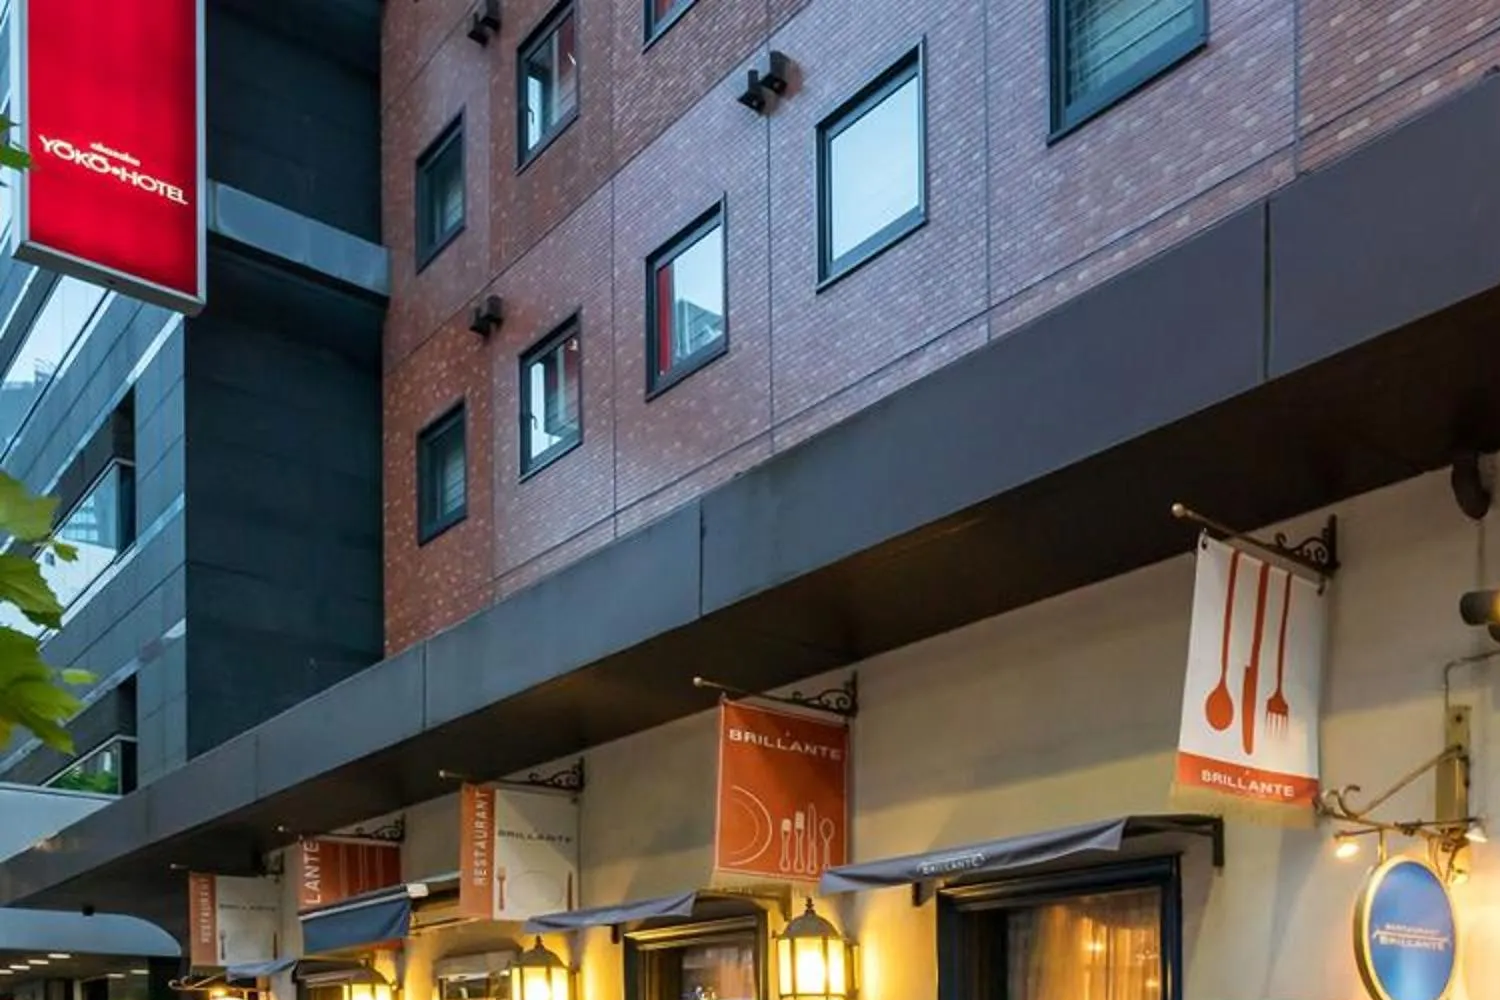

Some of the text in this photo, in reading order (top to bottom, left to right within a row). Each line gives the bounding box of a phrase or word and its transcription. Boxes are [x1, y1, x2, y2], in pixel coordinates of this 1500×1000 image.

[119, 166, 189, 206] HOTEL
[728, 727, 842, 761] BRILLANTE
[1200, 768, 1295, 798] BRILLANTE
[472, 790, 489, 887] RESTAURANT
[498, 829, 573, 844] BRILLANTE
[302, 840, 322, 905] LANTE
